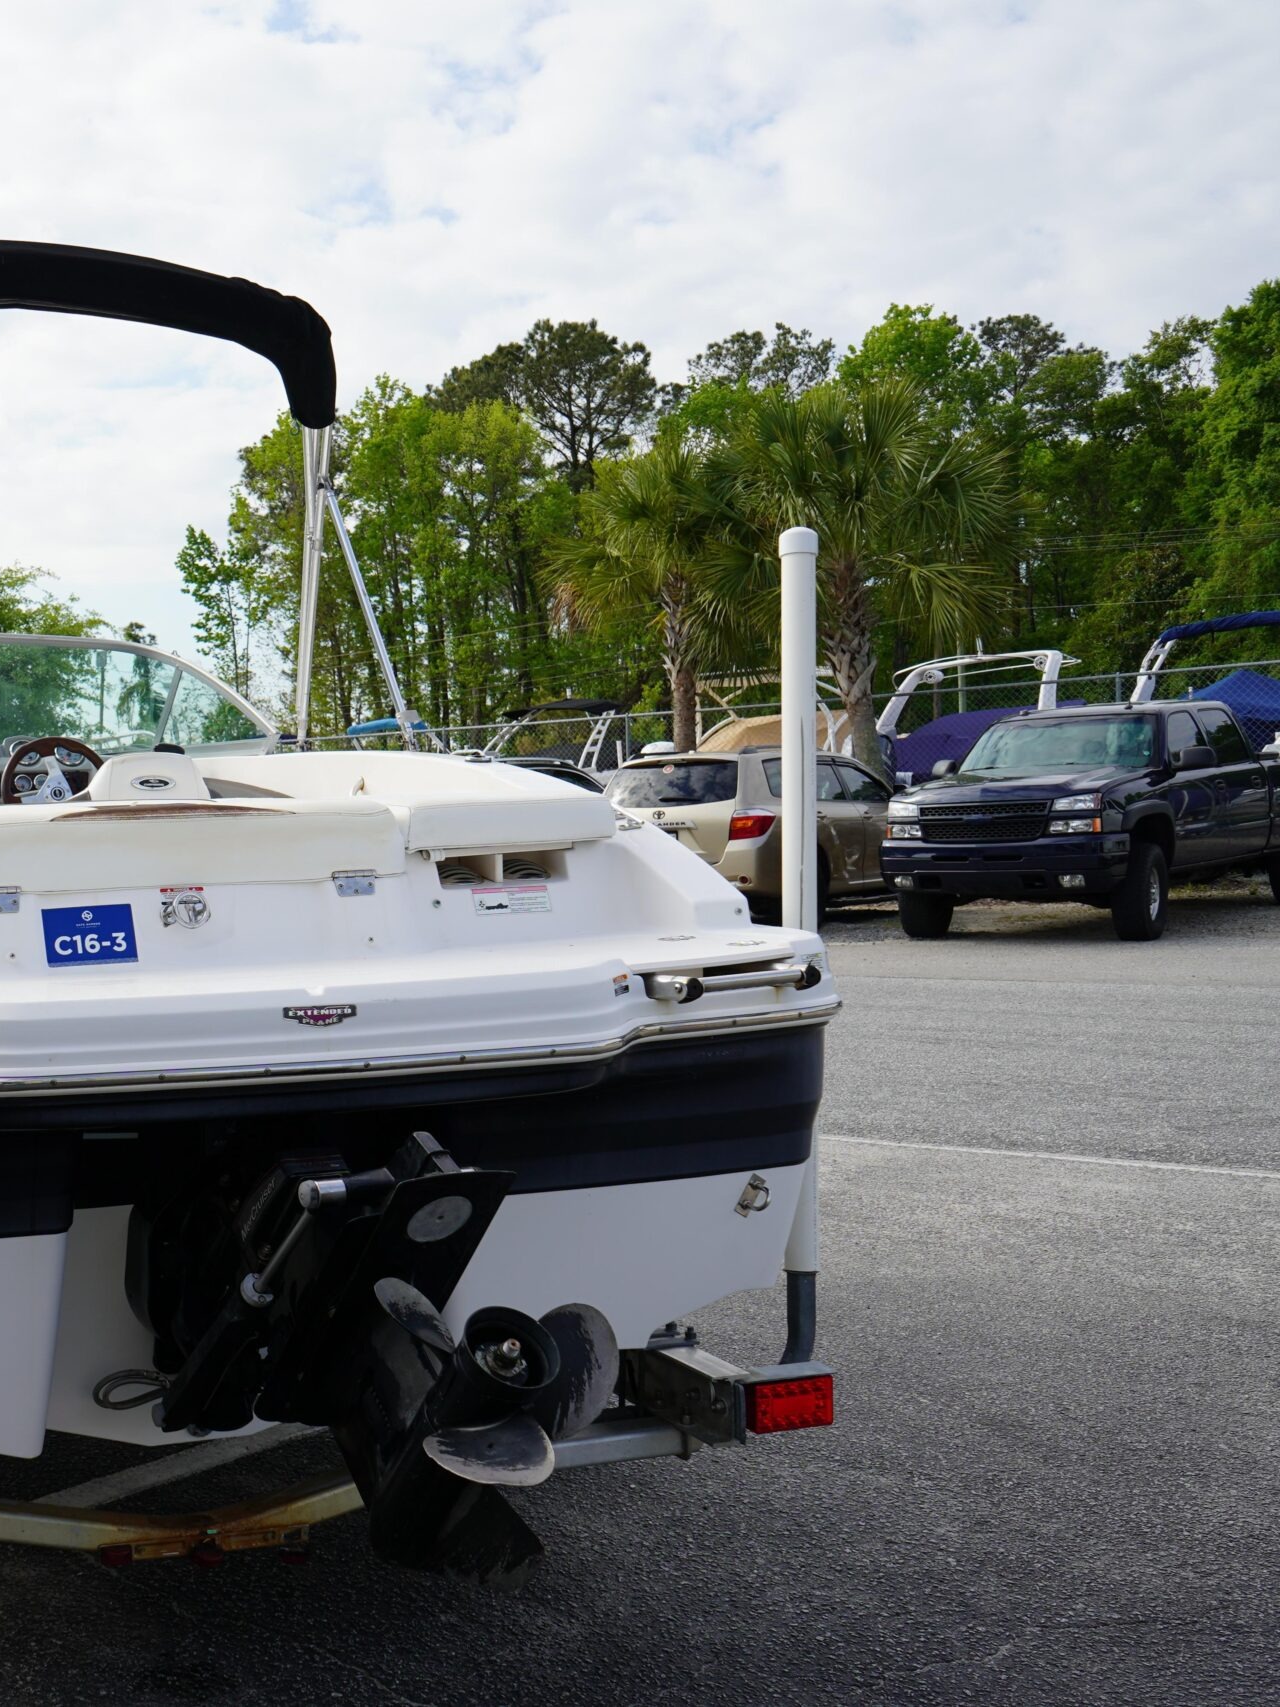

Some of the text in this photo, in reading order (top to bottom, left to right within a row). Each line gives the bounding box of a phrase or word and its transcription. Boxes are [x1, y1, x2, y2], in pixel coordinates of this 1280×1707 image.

[54, 932, 127, 956] C16-3
[288, 1008, 352, 1017] EXTENDED
[302, 1017, 339, 1026] PLANE
[241, 1177, 276, 1241] MerCruiser
